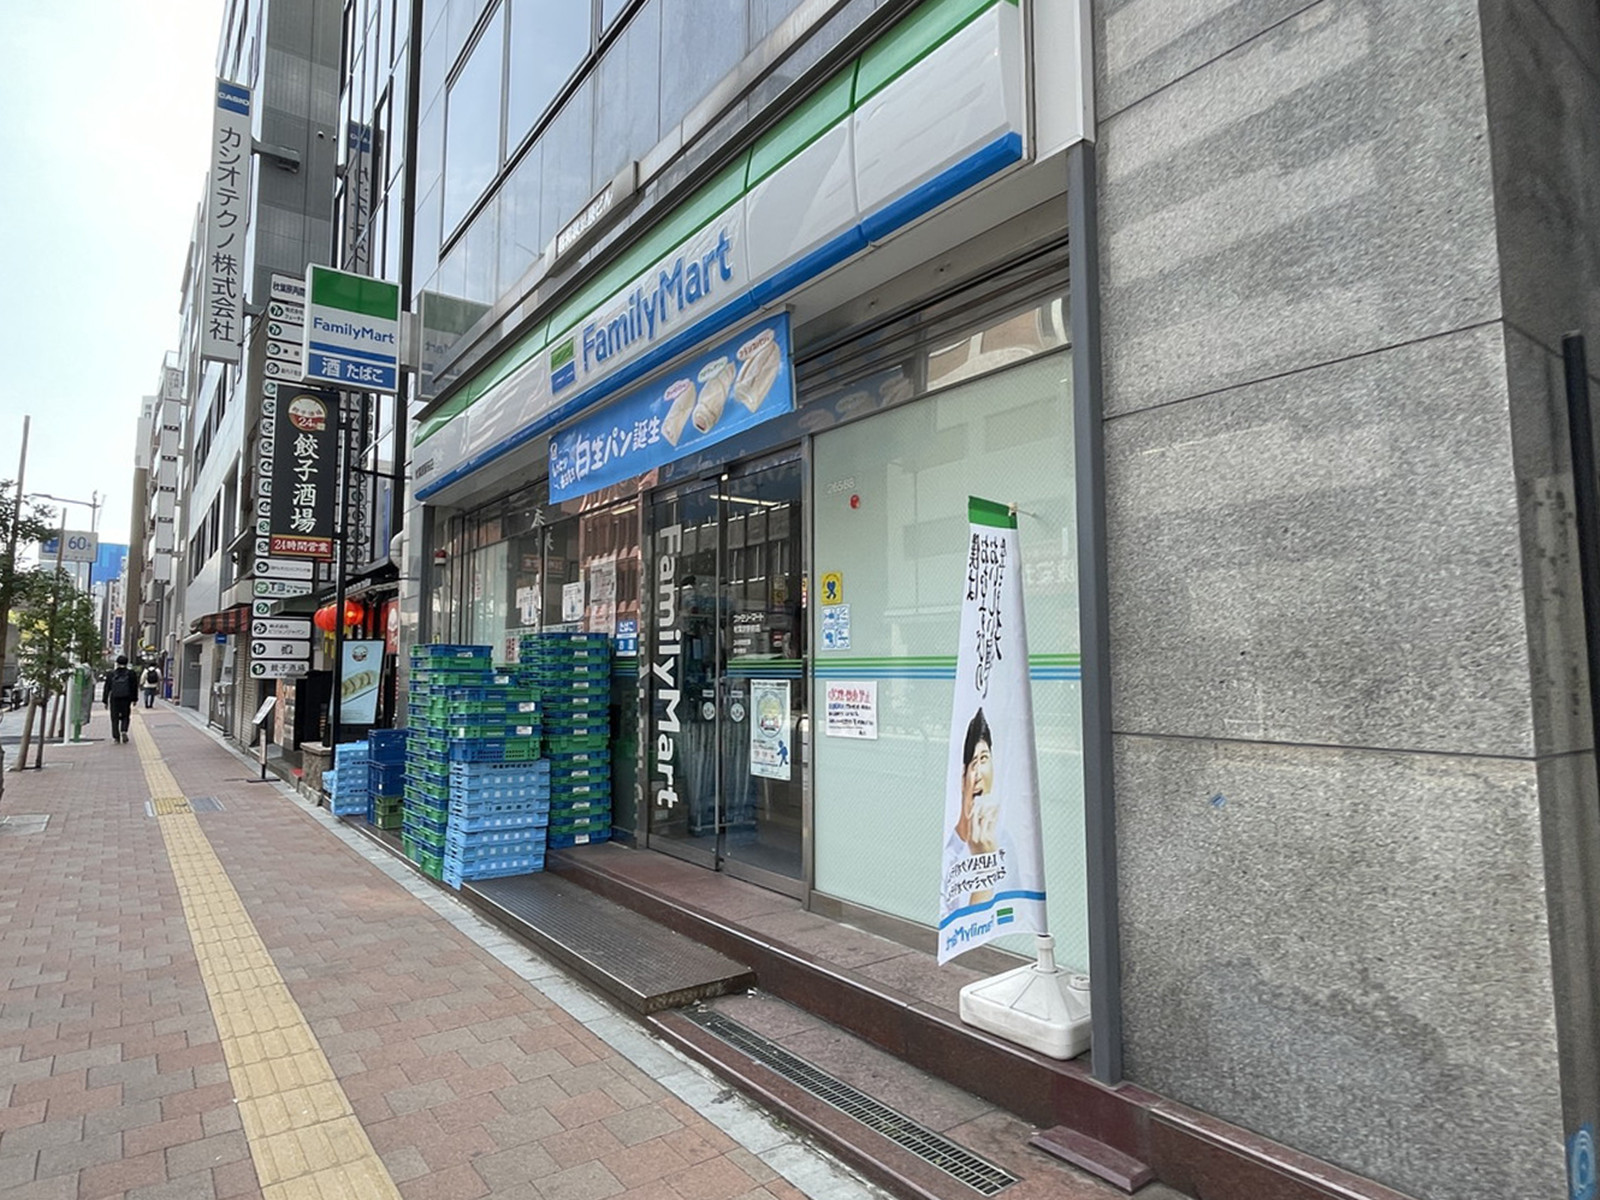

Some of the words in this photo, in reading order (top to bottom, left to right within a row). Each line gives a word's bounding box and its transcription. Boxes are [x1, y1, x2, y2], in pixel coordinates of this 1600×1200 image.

[217, 91, 250, 106] CASIO
[209, 126, 241, 342] カシオテクノ株式会社
[313, 317, 395, 345] FamilyMart
[583, 227, 732, 373] FamilyMart
[322, 358, 340, 377] 酒
[346, 363, 384, 384] たばこ
[576, 417, 661, 482] 白生パン誕生
[289, 433, 321, 535] 餃子酒場
[274, 539, 329, 555] 24時間営業
[653, 522, 682, 810] FamilyMart
